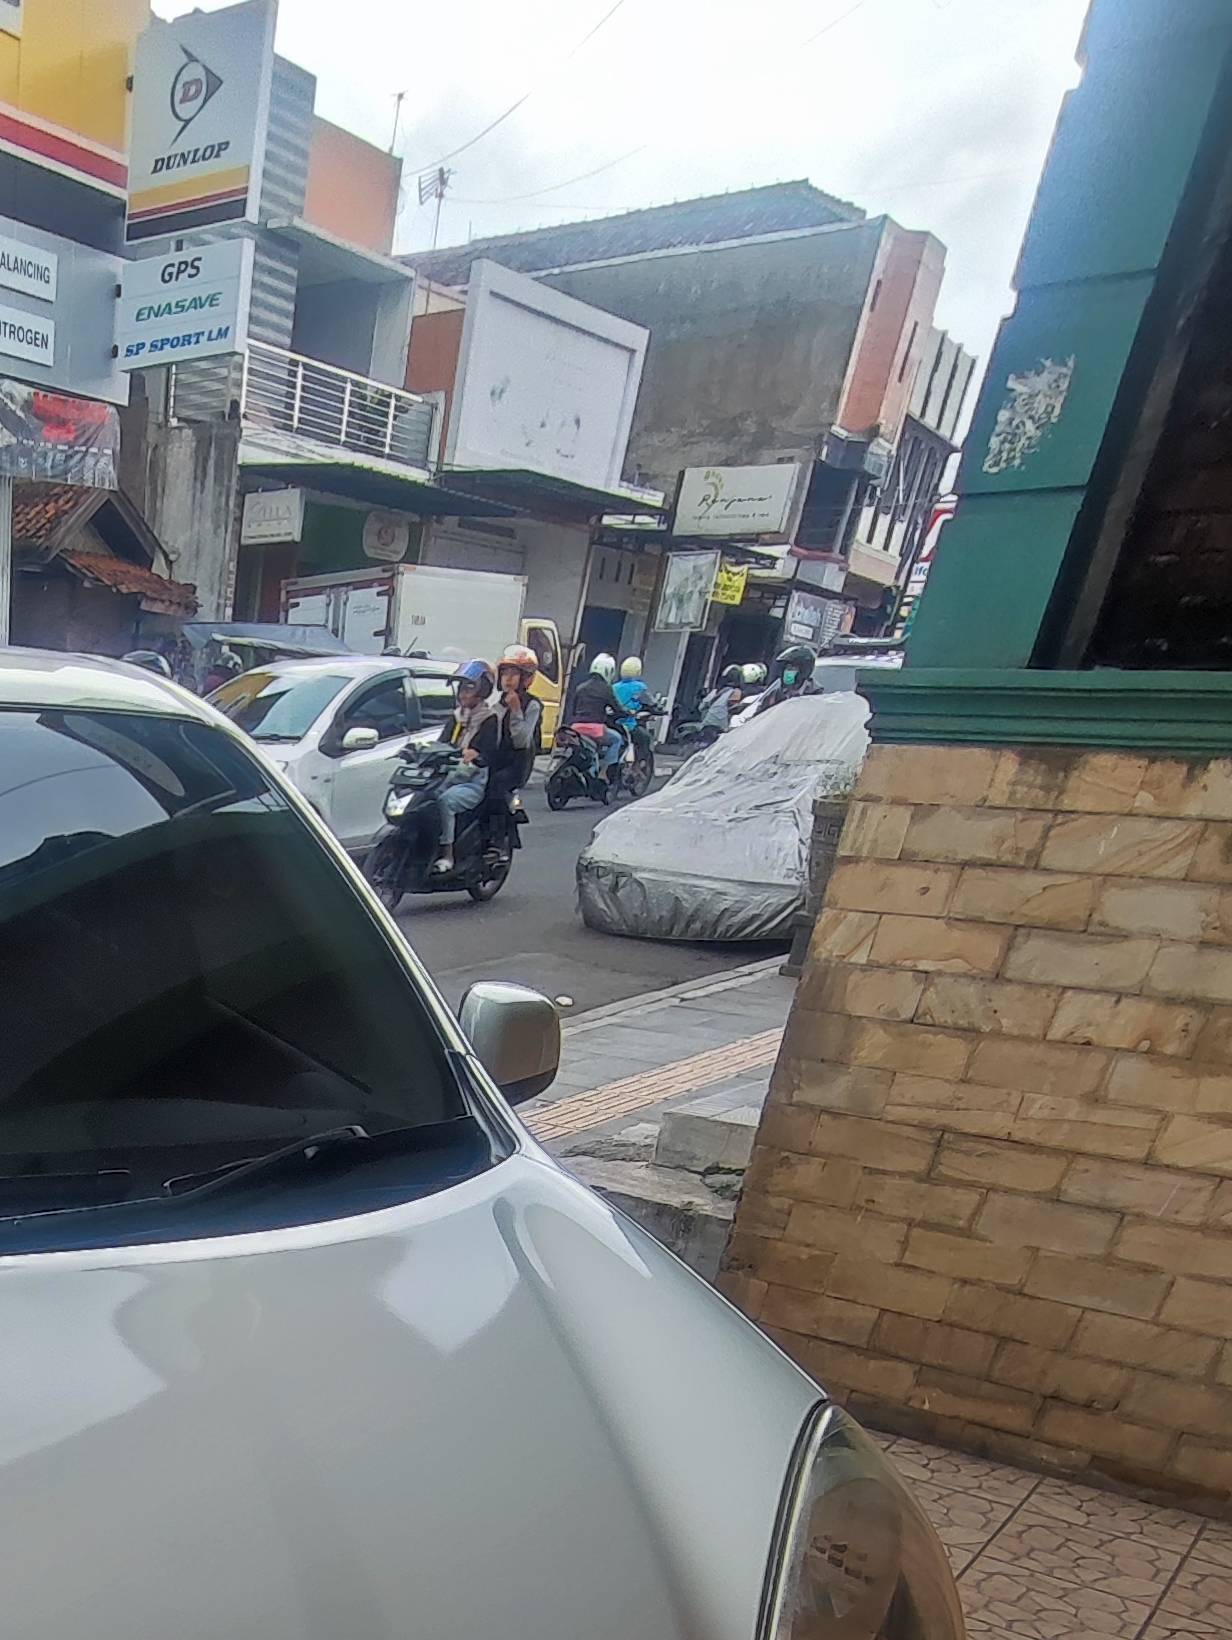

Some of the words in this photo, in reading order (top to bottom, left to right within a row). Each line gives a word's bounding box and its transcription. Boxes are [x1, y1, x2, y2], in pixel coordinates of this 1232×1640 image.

[179, 78, 203, 104] D
[150, 141, 230, 175] DUNLOP
[160, 256, 202, 284] GPS
[135, 292, 223, 322] ENASAVE
[124, 341, 146, 358] SP
[148, 331, 205, 353] SPORT
[207, 326, 230, 342] LM
